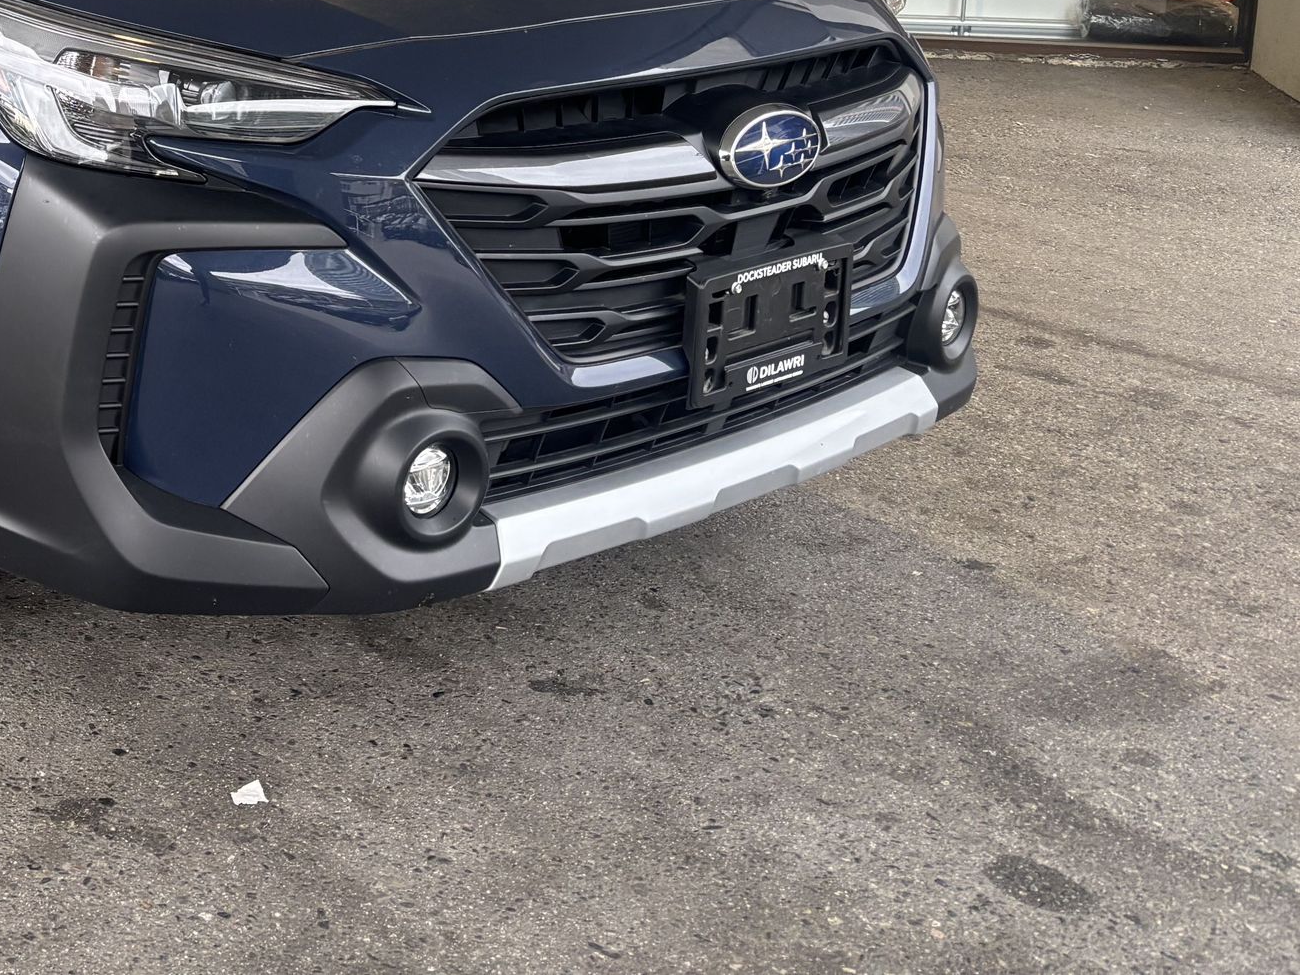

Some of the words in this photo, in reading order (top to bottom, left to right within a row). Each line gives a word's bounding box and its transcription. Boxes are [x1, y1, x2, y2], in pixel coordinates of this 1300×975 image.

[737, 260, 792, 284] DOCKSTEADER
[792, 252, 823, 270] SUBARU
[759, 354, 805, 379] DILAWRI
